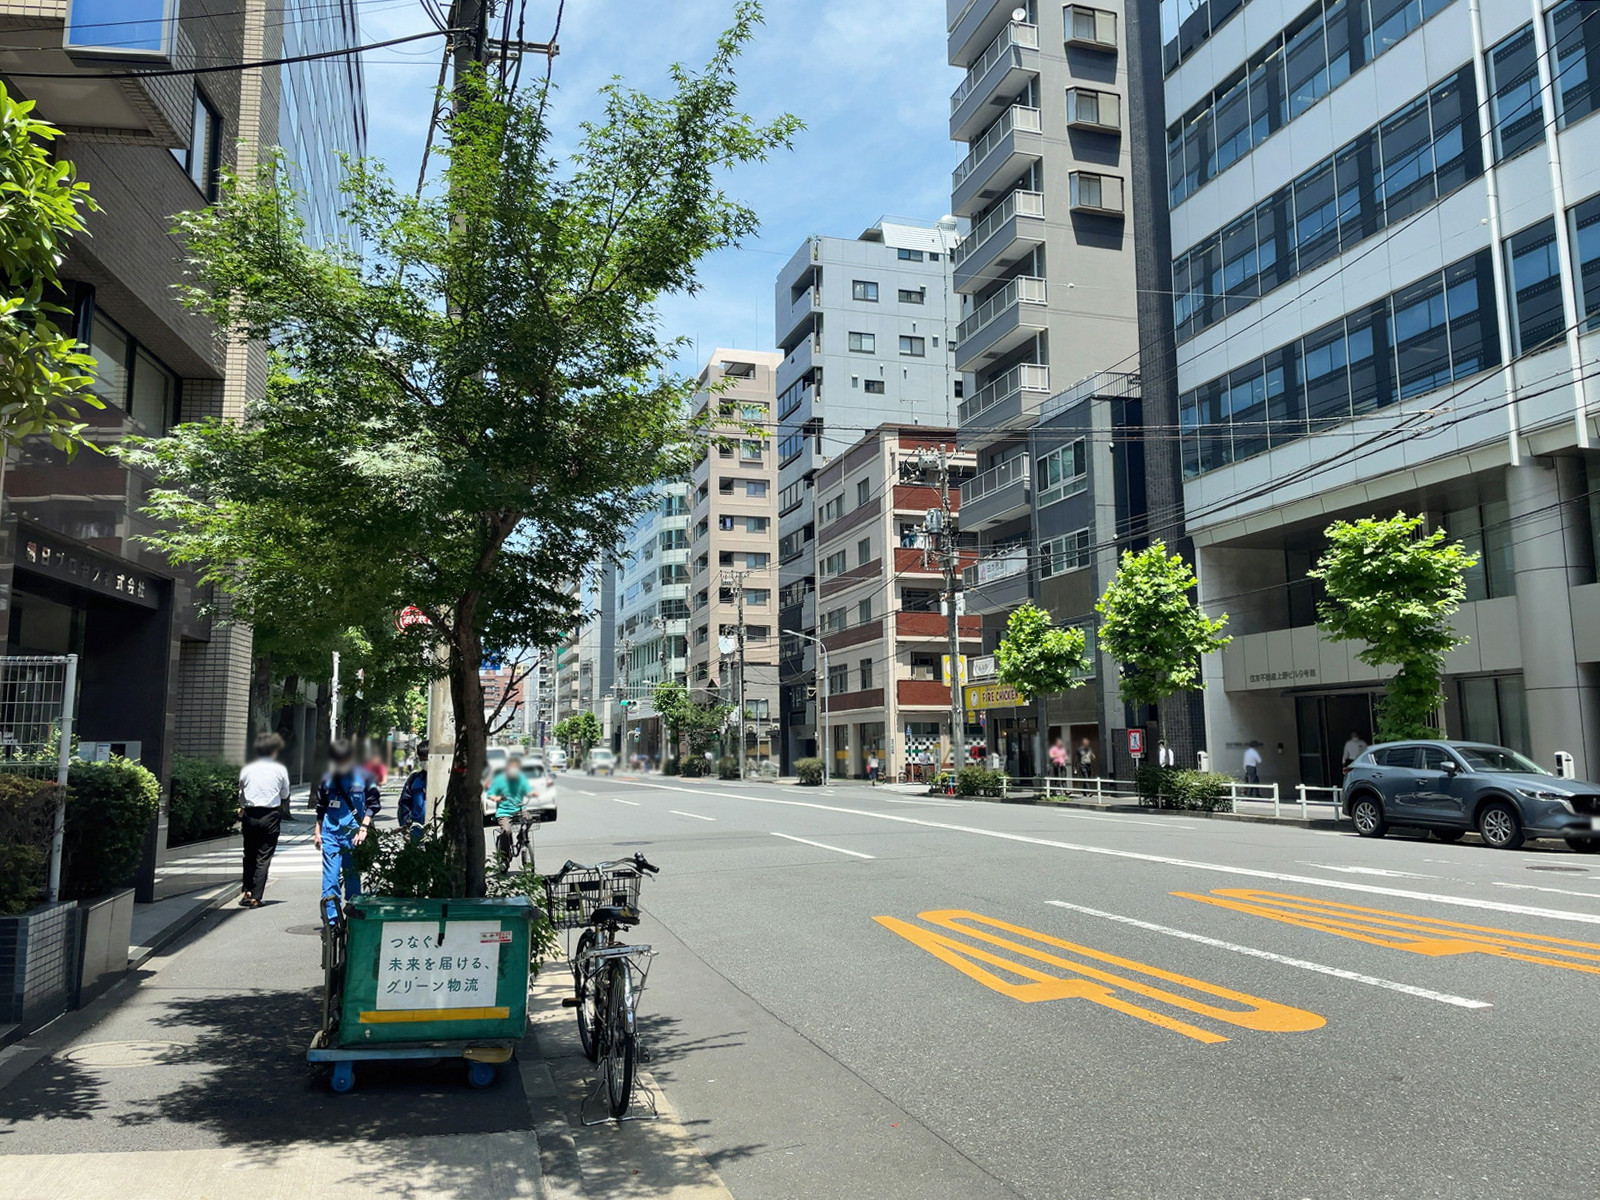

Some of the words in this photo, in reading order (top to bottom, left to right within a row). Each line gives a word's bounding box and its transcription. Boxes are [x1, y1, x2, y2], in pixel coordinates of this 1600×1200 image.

[982, 691, 995, 702] FIRE
[388, 956, 490, 971] 未来を届ける、
[386, 978, 479, 994] グリーン物流
